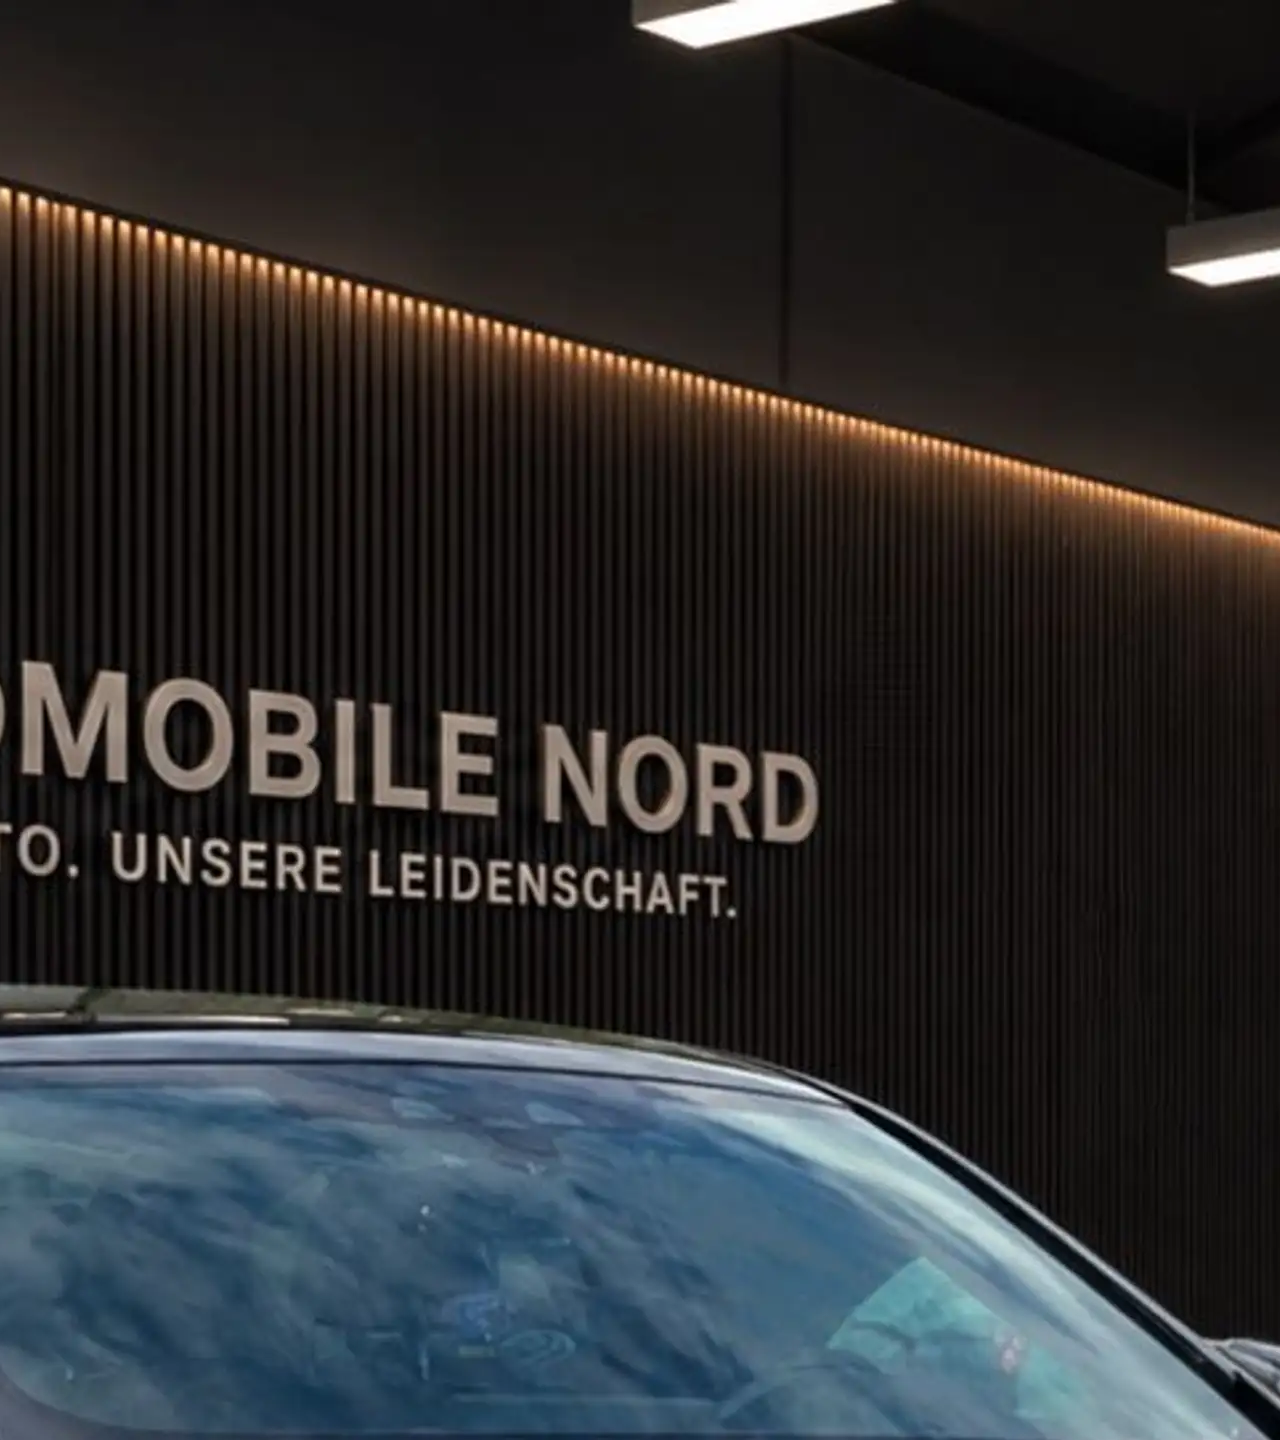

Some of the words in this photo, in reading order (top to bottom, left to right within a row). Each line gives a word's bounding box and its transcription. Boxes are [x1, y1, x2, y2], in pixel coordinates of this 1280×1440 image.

[543, 724, 819, 843] NORD
[112, 831, 343, 894] UNSERE
[370, 849, 738, 919] LEIDENSCHAFT.
